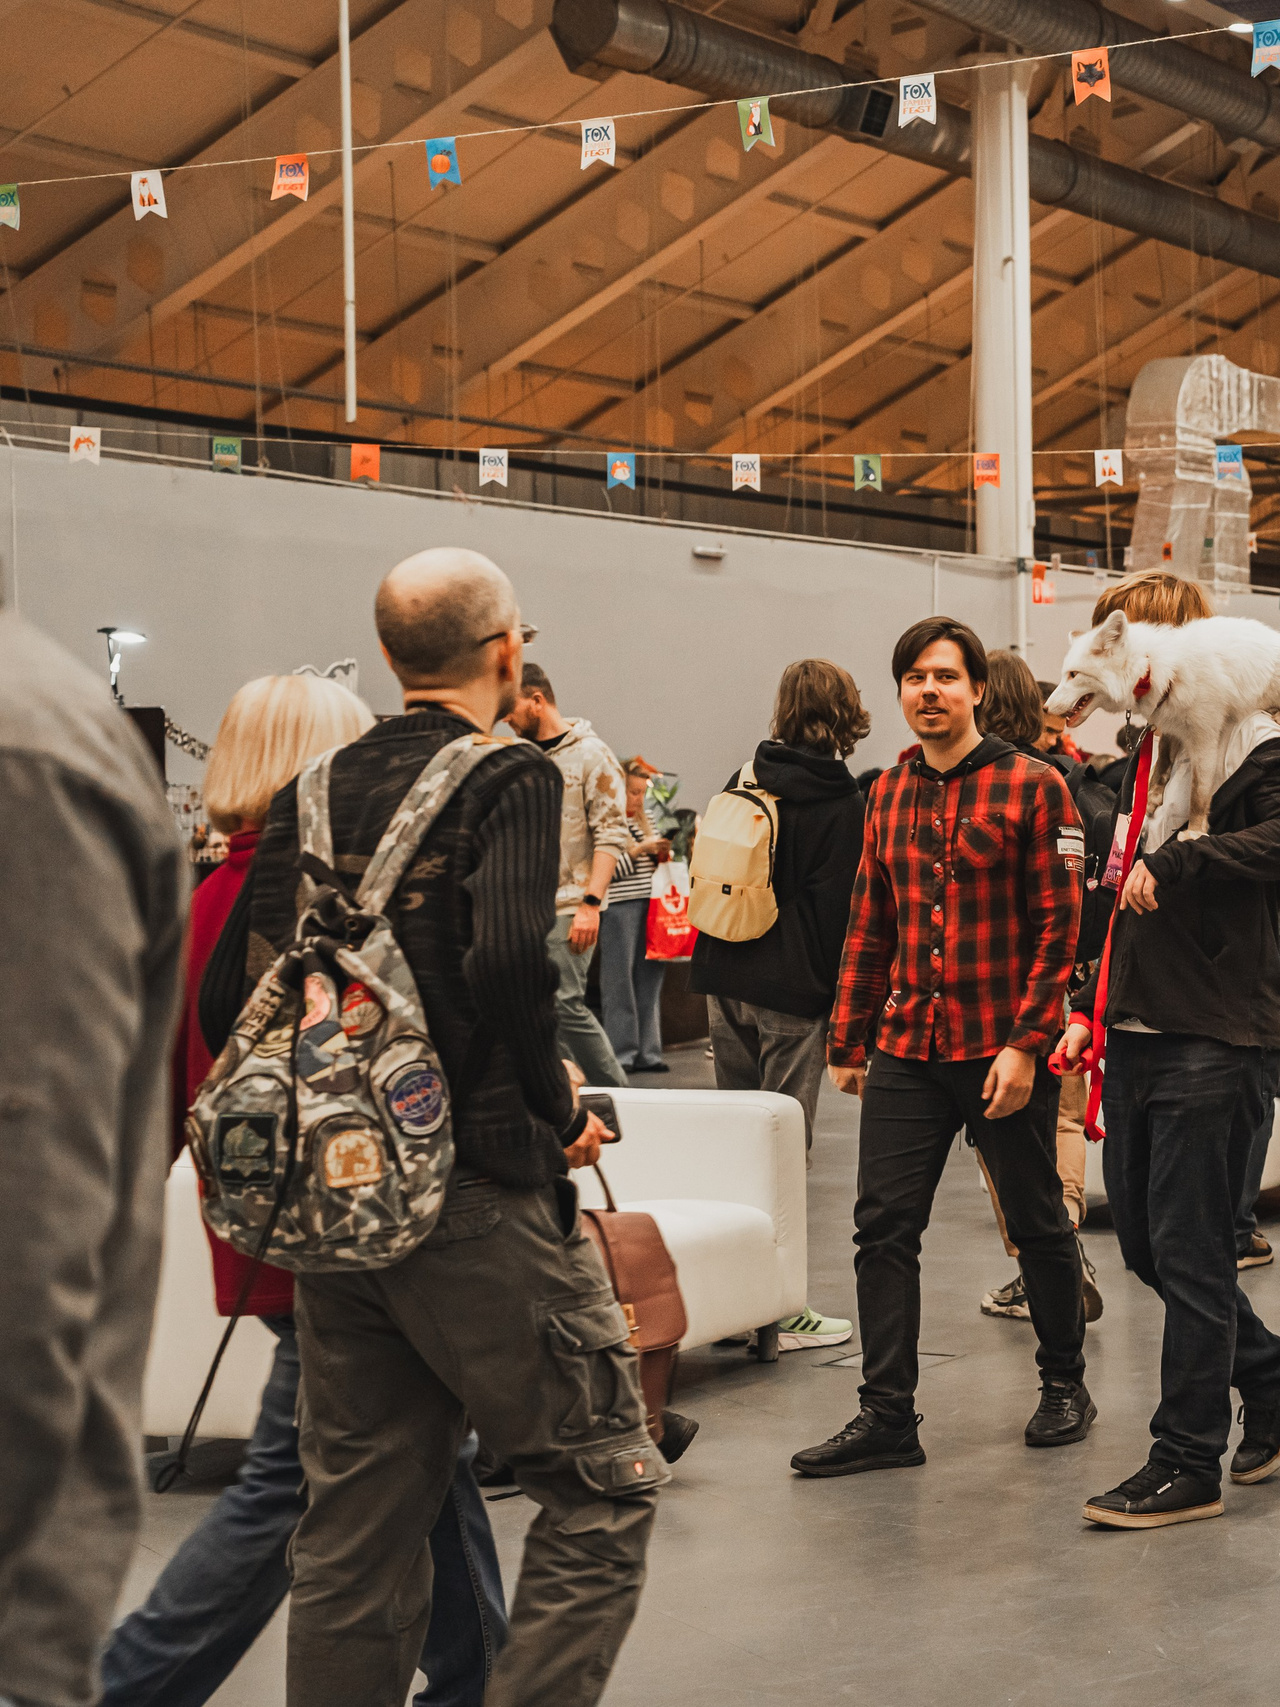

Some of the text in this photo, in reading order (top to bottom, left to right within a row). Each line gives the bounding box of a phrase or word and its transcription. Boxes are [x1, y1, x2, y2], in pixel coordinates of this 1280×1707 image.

[903, 82, 932, 100] FOX
[903, 105, 932, 115] FEST
[585, 126, 611, 143] FOX
[585, 148, 611, 157] FEST
[280, 162, 305, 178] FOX
[0, 192, 16, 207] OX
[215, 443, 236, 454] FOX
[482, 455, 504, 466] FOX
[1218, 451, 1240, 462] FOX
[735, 460, 757, 471] FOX
[976, 459, 997, 470] FOX
